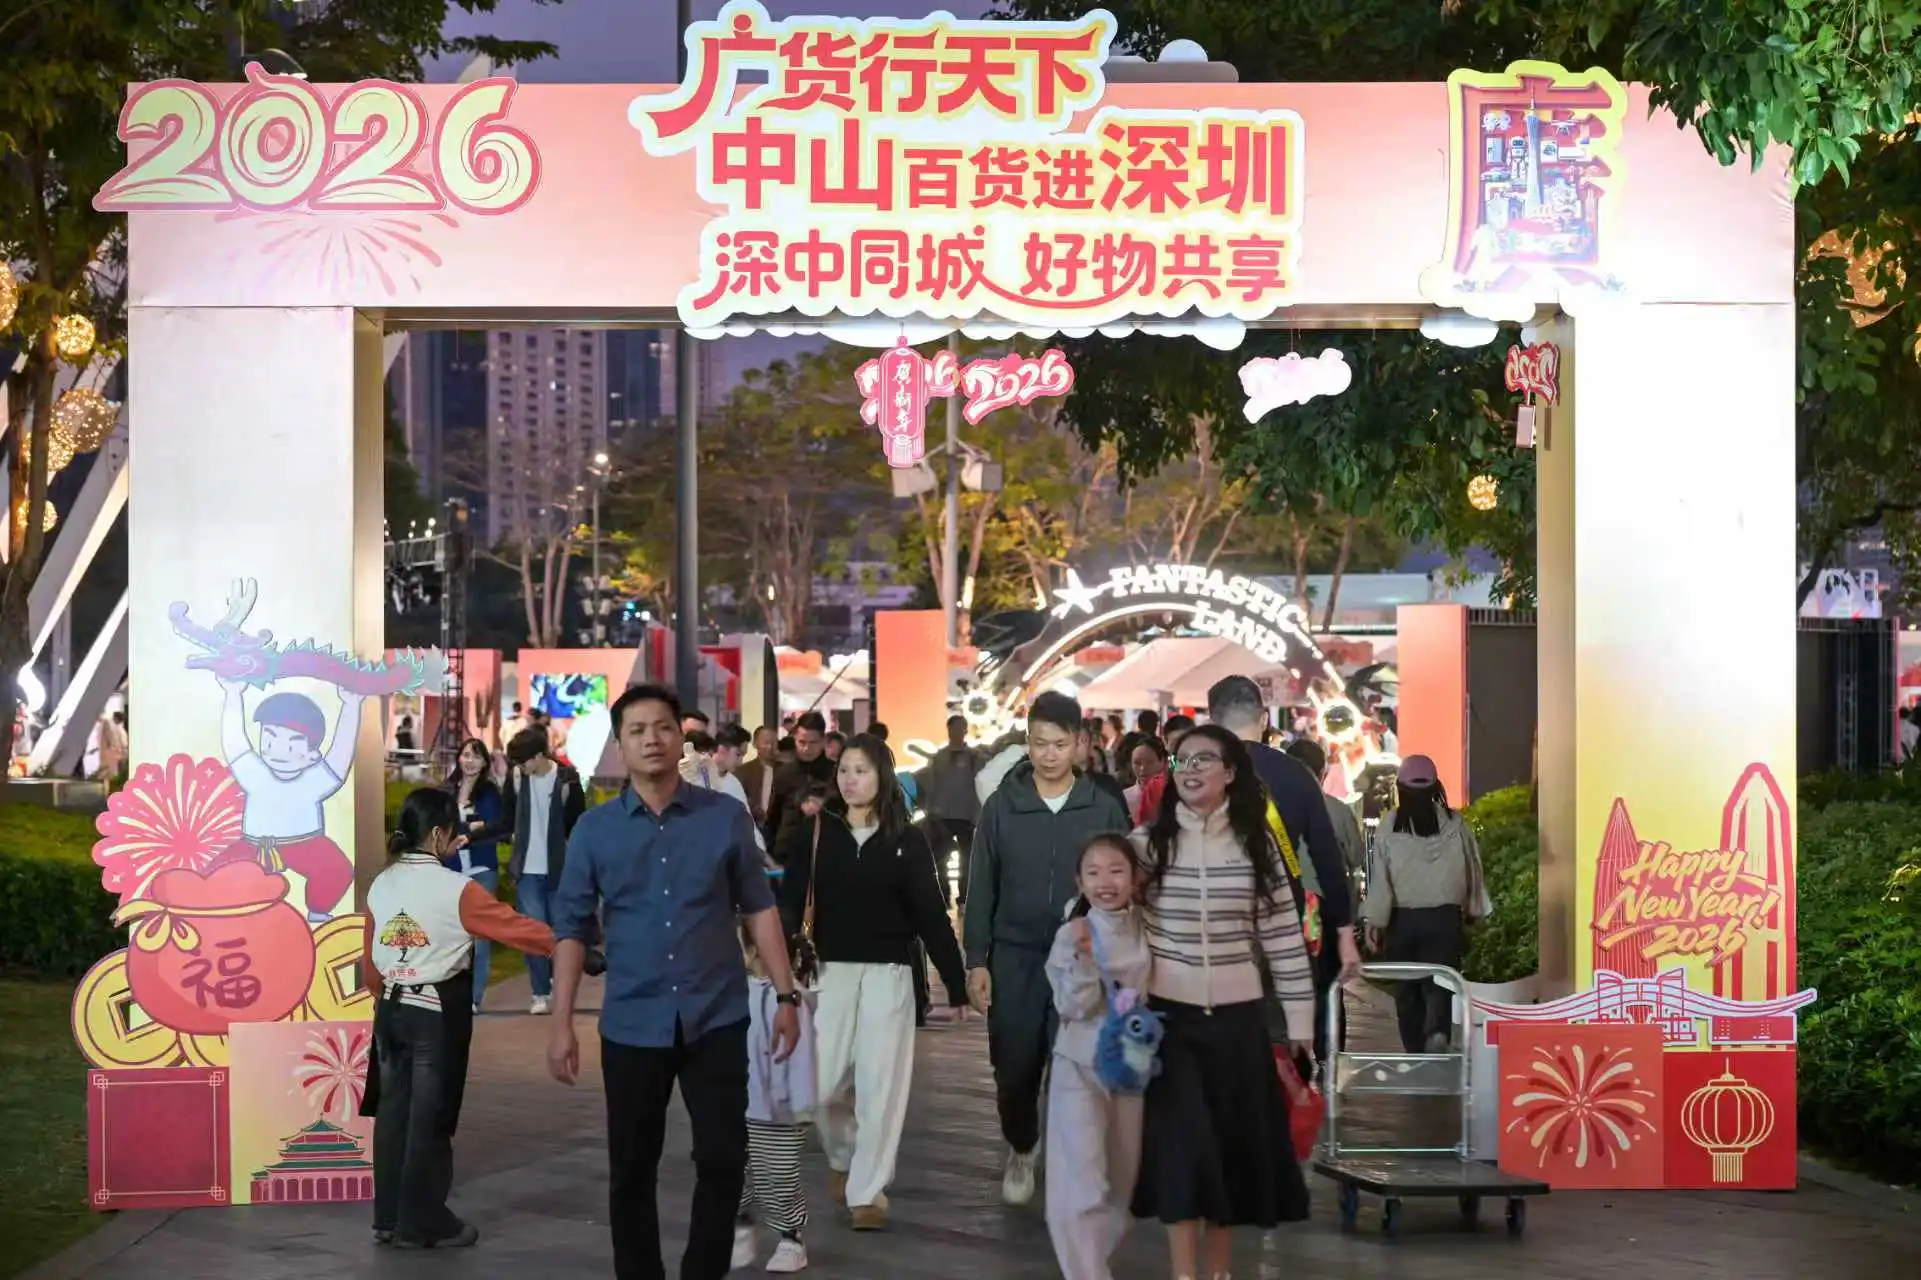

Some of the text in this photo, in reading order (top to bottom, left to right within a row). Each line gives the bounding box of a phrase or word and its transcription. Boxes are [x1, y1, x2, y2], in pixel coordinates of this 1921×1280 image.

[646, 14, 1098, 137] 广货行天下
[93, 62, 541, 215] 2026
[712, 116, 1287, 215] 中山百货进深圳
[692, 225, 1286, 310] 深中同城 好物共享
[962, 350, 1072, 423] 2026
[1109, 564, 1307, 633] FANTASTIC
[1189, 600, 1287, 663] LAND
[1619, 841, 1767, 893] Happy
[1596, 885, 1780, 931] New Year!
[1640, 917, 1747, 965] 2026
[181, 937, 262, 1009] 福
